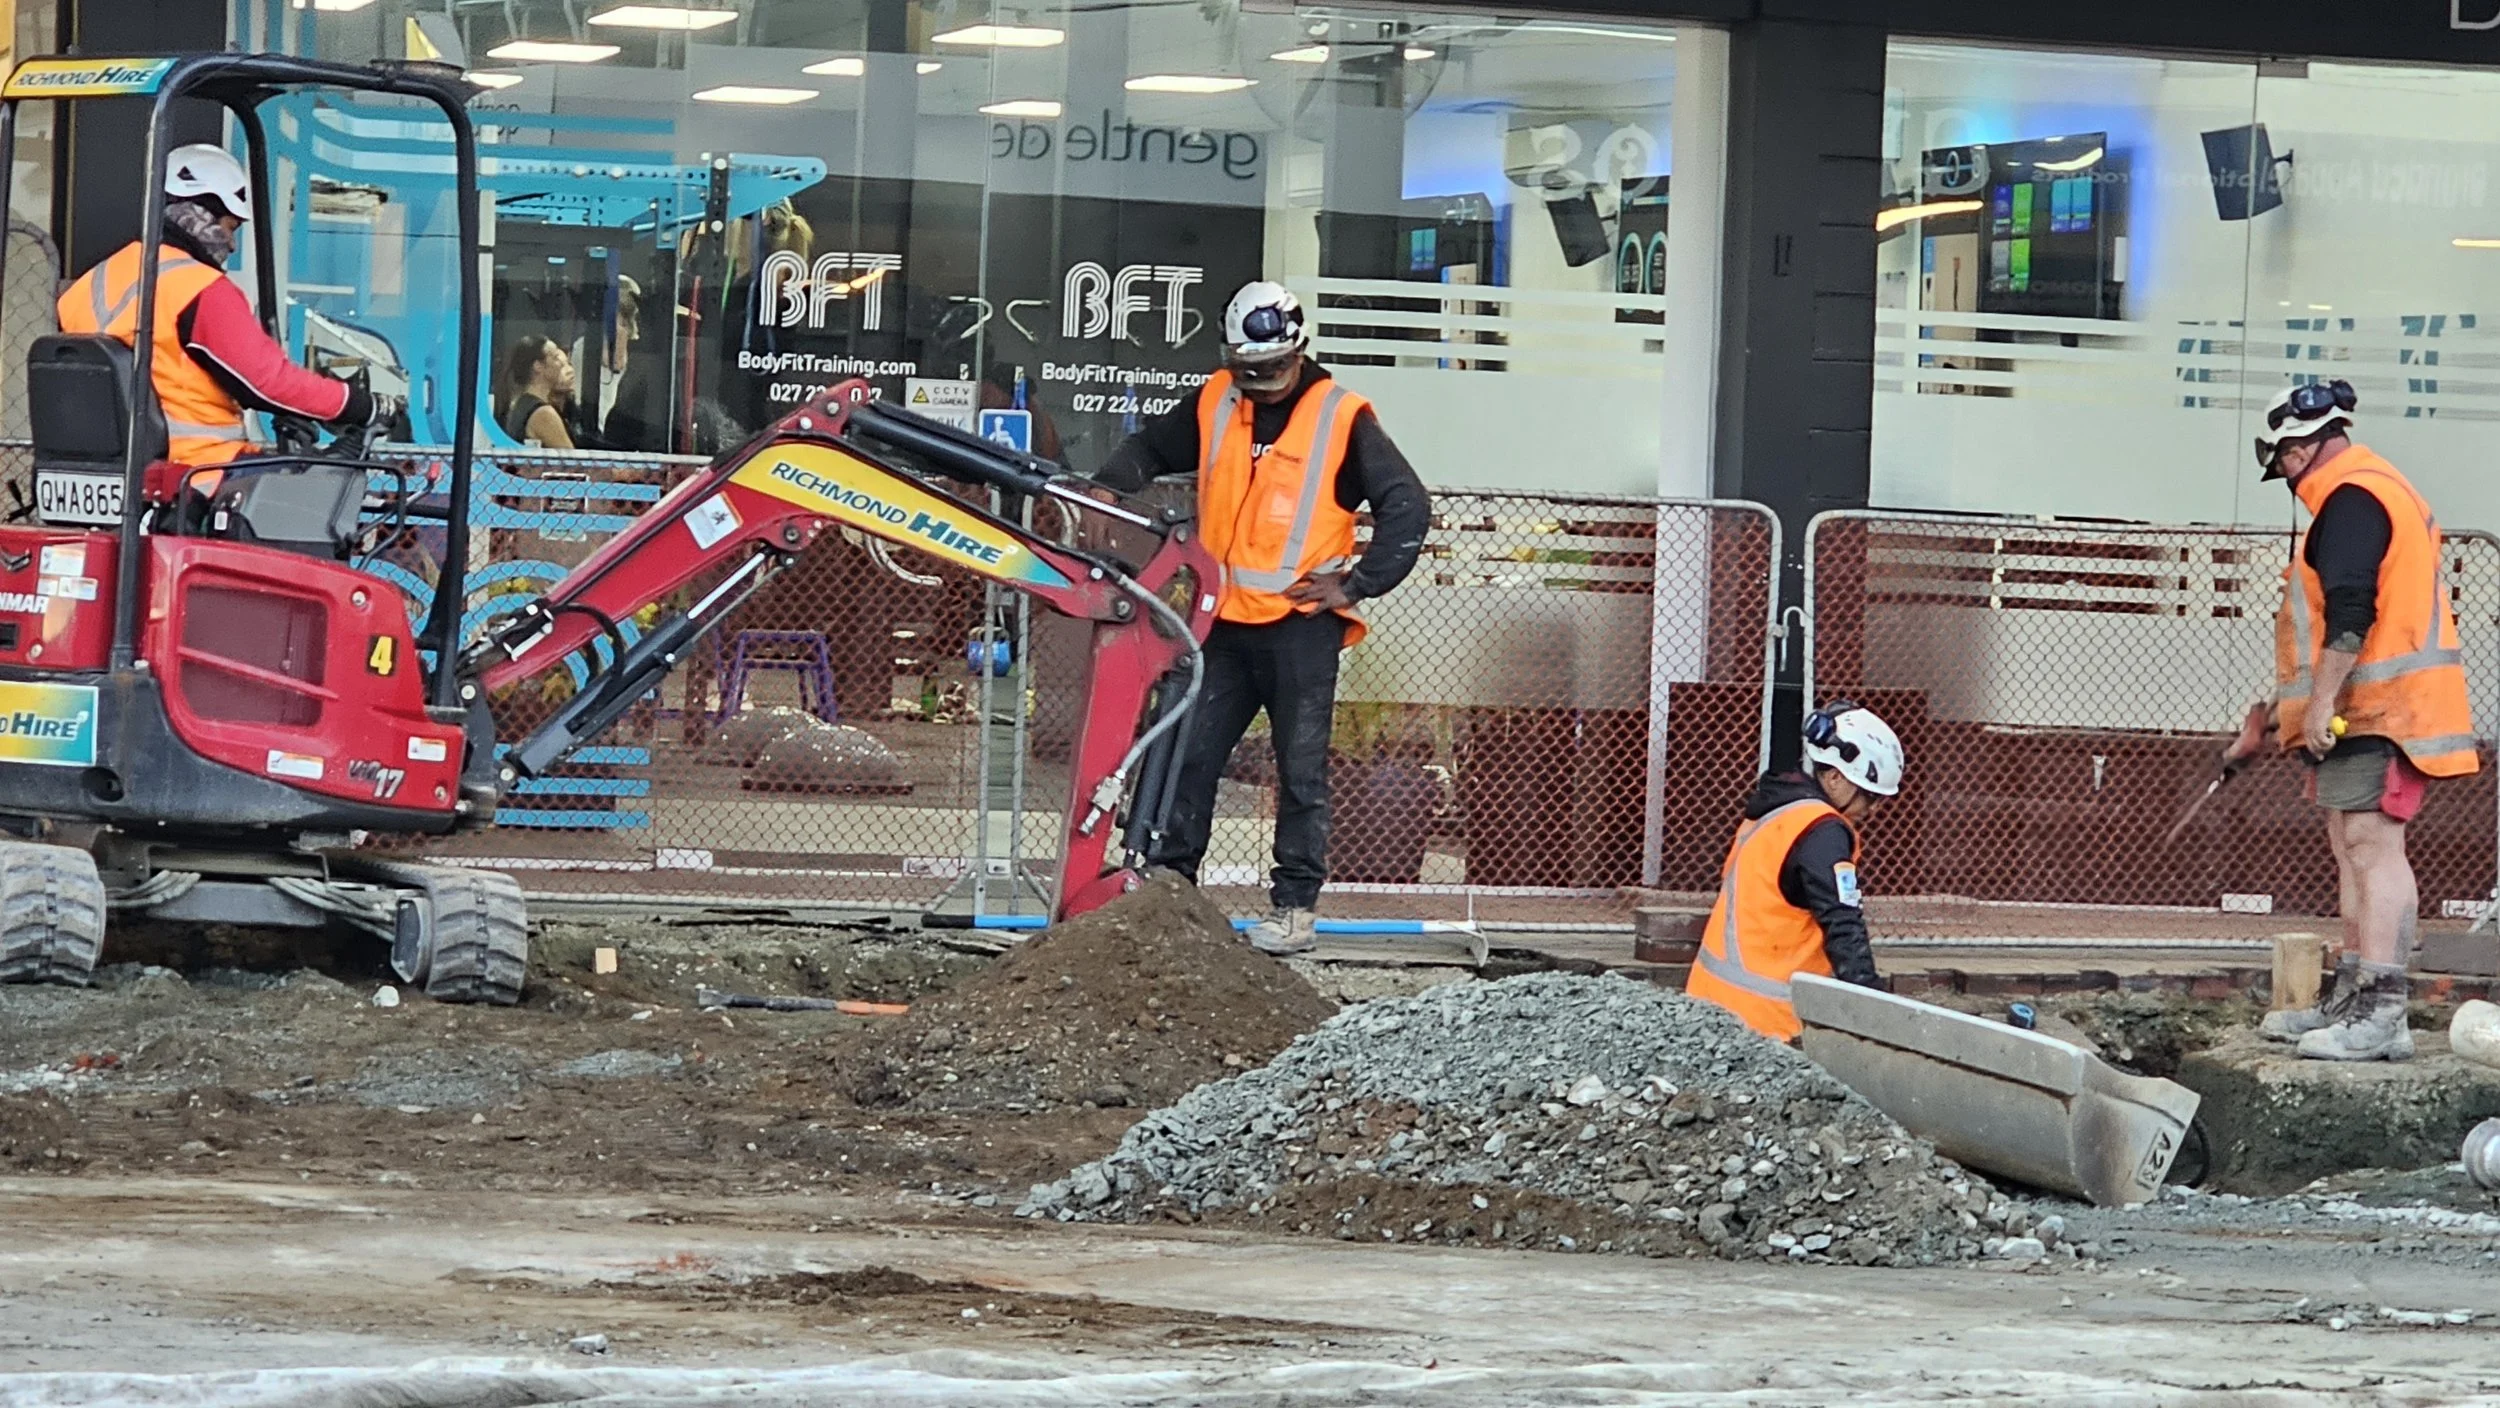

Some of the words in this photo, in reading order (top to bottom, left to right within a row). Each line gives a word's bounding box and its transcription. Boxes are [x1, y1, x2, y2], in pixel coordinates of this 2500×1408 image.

[15, 72, 99, 86] RICHMOND
[94, 66, 153, 84] HIRE
[759, 250, 902, 331] BFT
[1062, 261, 1203, 342] BFT
[738, 351, 917, 377] BodyFitTraining.com
[770, 382, 802, 402] 027
[933, 386, 970, 396] CCTV
[1072, 393, 1106, 413] 027
[1107, 395, 1140, 415] 224
[771, 462, 908, 525] RICHMOND
[907, 512, 1004, 565] HIRE
[370, 636, 392, 675] 4
[10, 711, 77, 738] HIRE
